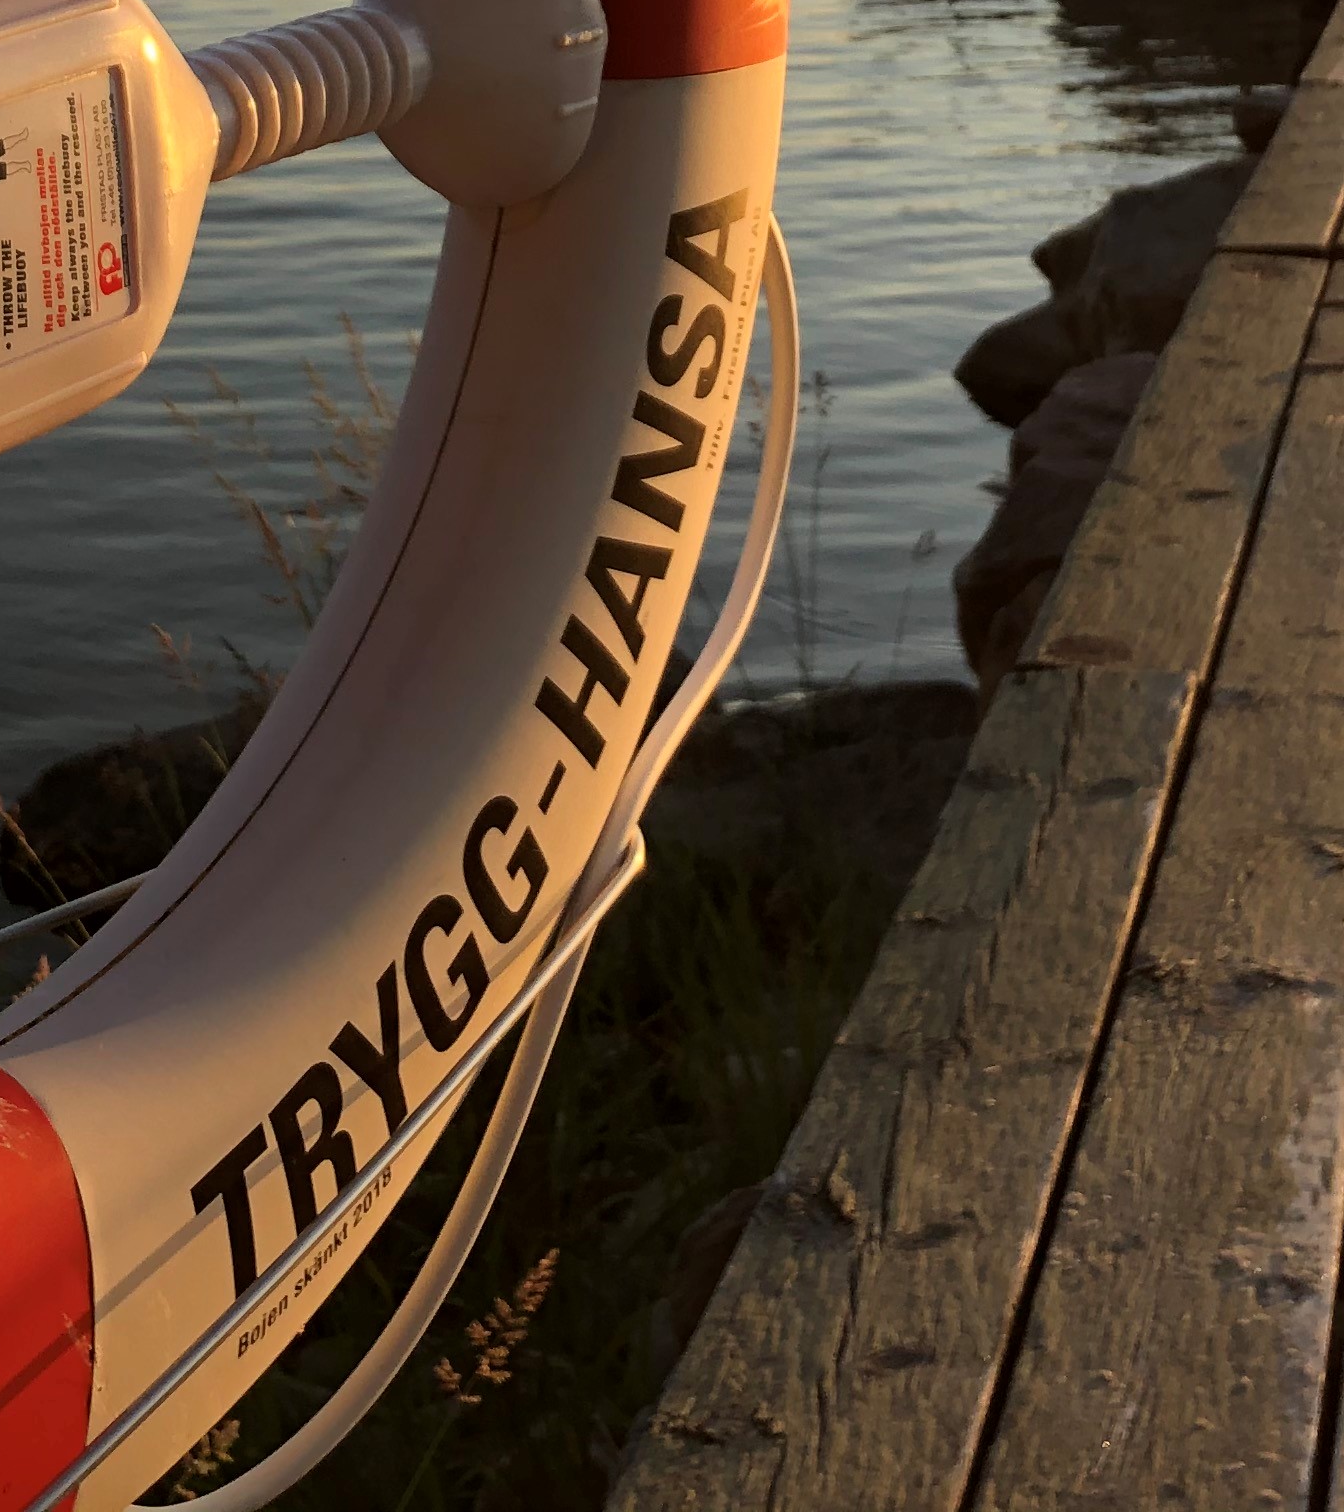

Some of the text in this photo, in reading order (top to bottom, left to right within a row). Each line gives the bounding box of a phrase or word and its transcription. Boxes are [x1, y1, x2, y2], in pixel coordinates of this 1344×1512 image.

[40, 204, 51, 265] livbojen
[61, 134, 80, 321] Keep always the lifebuoy
[66, 92, 92, 317] between you and the rescued.
[1, 239, 14, 336] THROW THE
[16, 249, 28, 328] LIFEBUOY
[53, 240, 63, 267] den
[55, 272, 65, 299] och
[42, 270, 53, 308] alltid
[43, 313, 54, 333] Ha
[56, 304, 67, 327] dig
[191, 187, 750, 1297] TRYGG-HANSA
[237, 1163, 393, 1360] Bojen skänkt 2018
